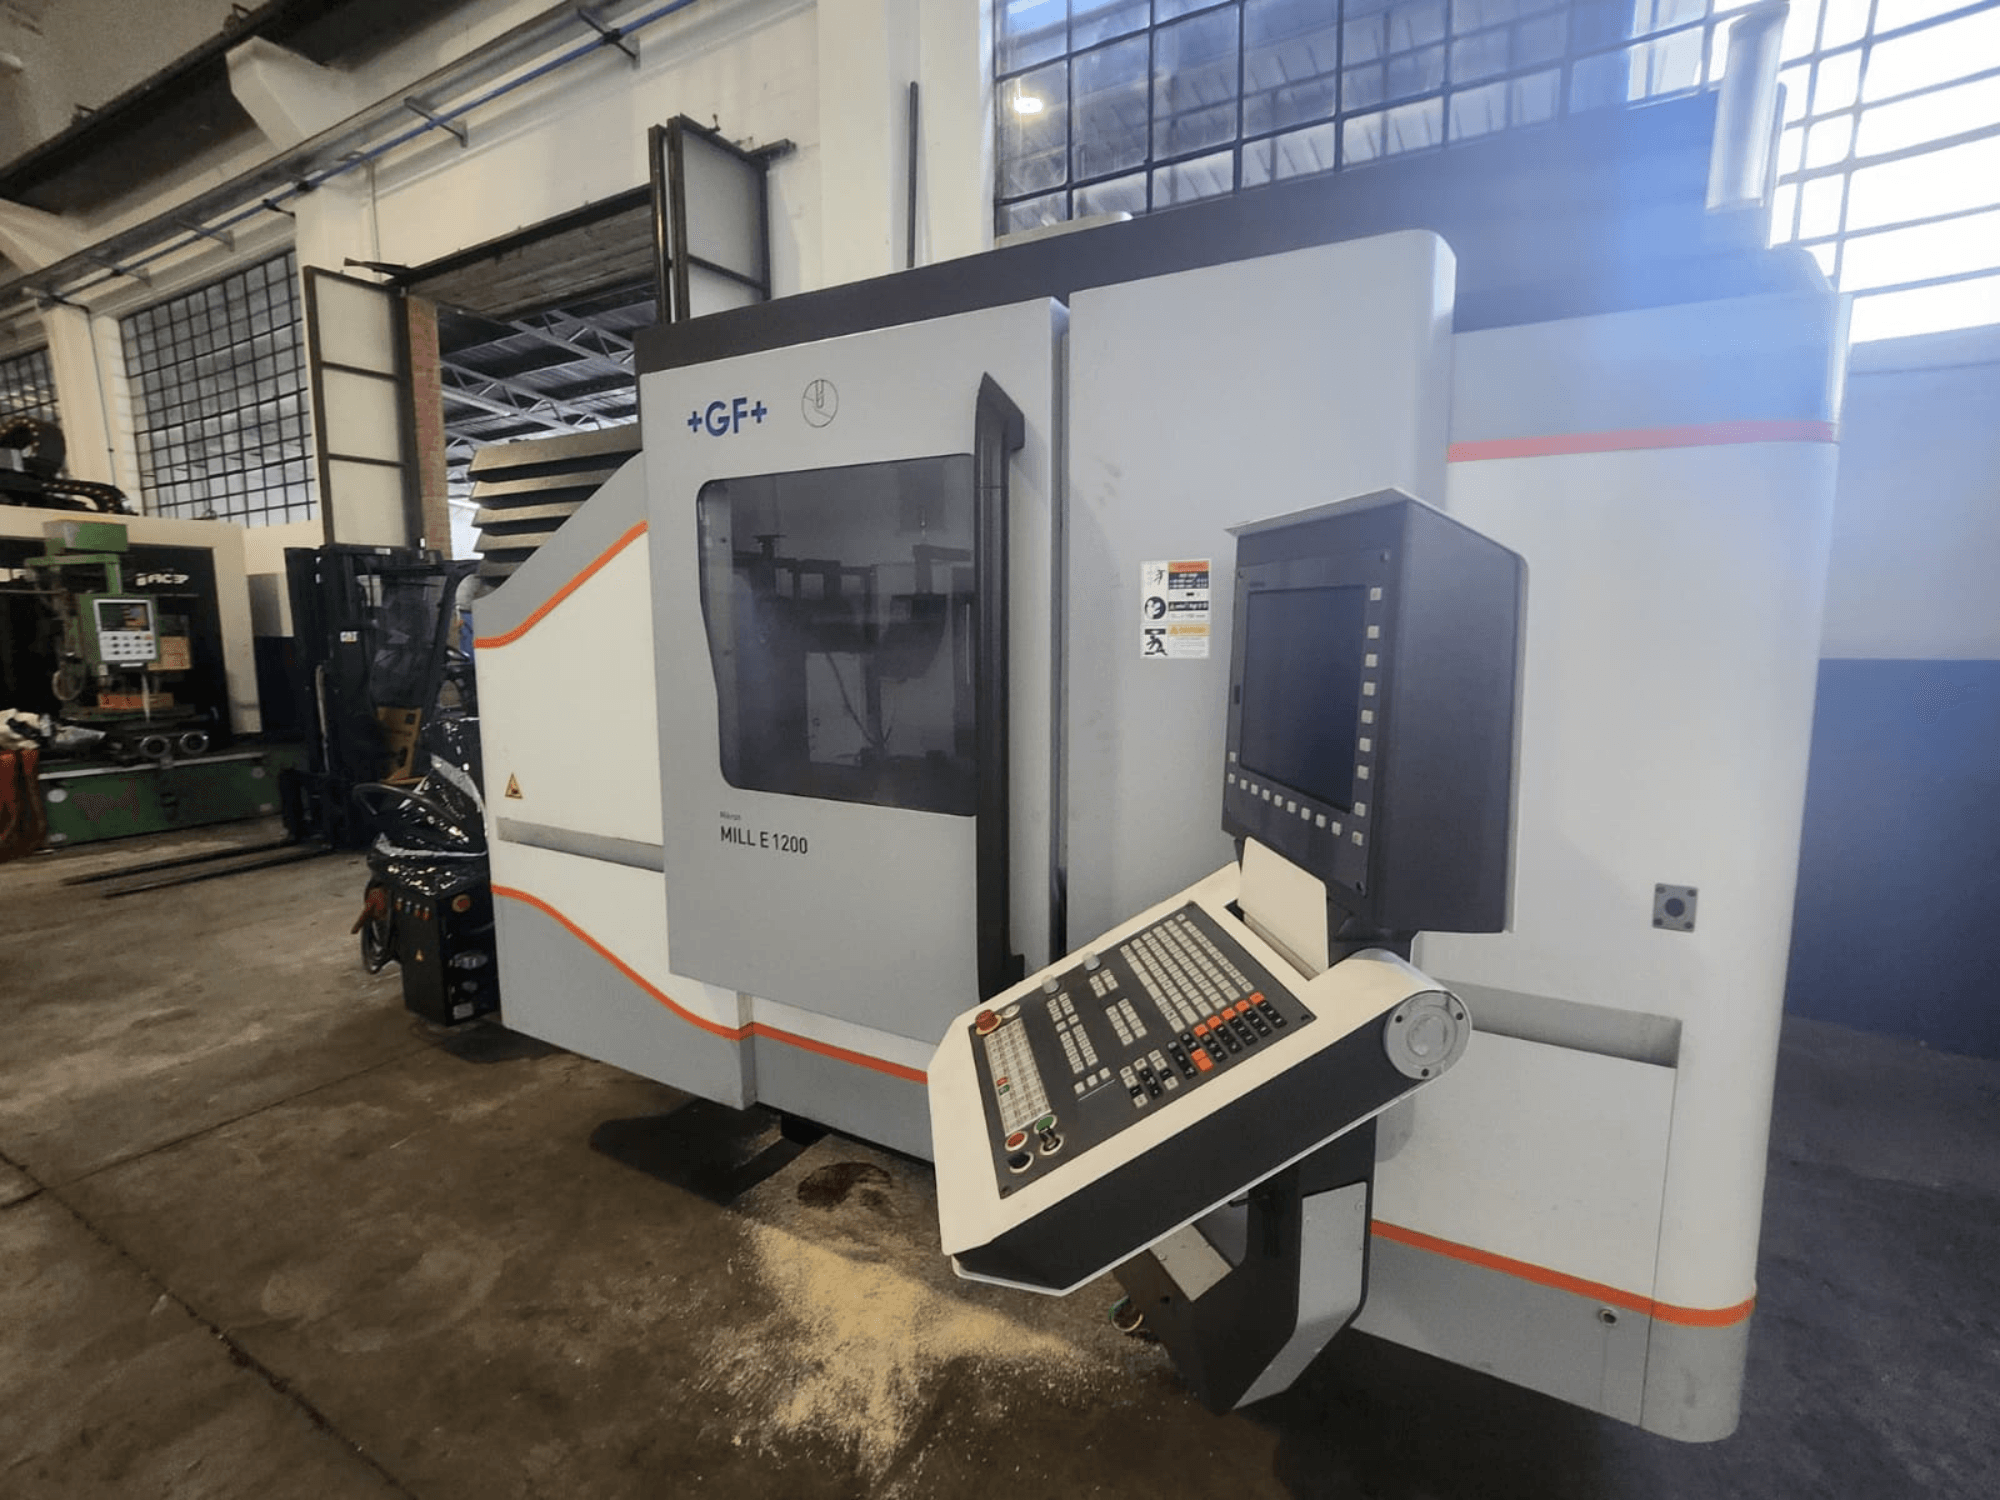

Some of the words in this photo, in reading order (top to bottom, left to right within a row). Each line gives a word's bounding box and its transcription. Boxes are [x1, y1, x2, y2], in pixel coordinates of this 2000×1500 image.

[720, 825, 756, 846] MILL
[760, 831, 769, 848] E
[772, 833, 808, 854] 1200
